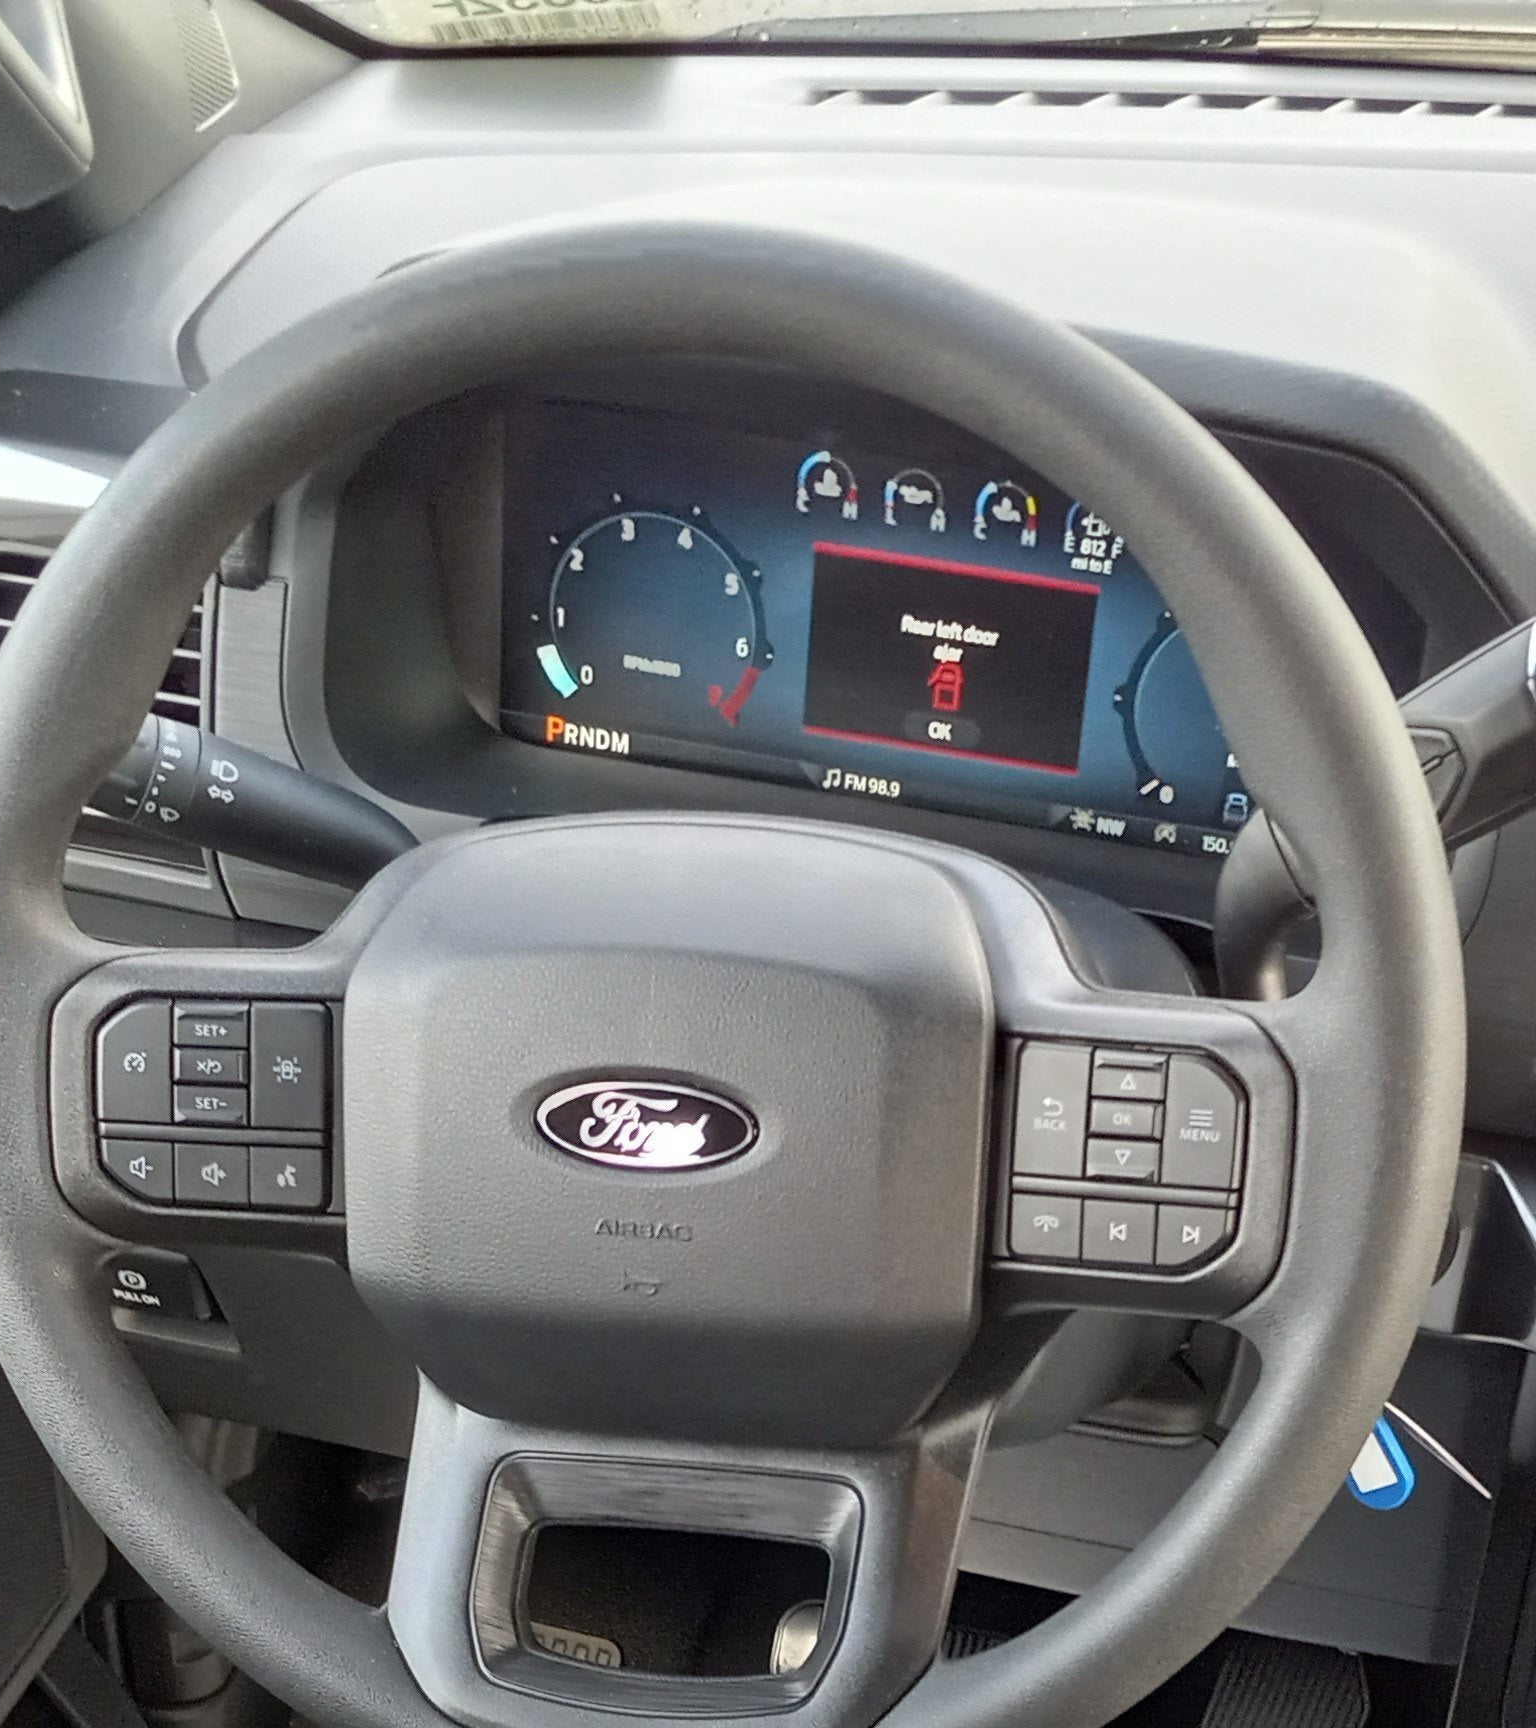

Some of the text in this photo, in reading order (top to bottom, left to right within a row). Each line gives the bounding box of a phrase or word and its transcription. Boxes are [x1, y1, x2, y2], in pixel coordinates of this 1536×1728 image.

[735, 636, 749, 658] 6
[963, 625, 1000, 647] door
[927, 721, 953, 741] OK
[843, 772, 901, 798] FM 98.9
[578, 1090, 712, 1160] Ford
[1179, 1127, 1221, 1144] MENU
